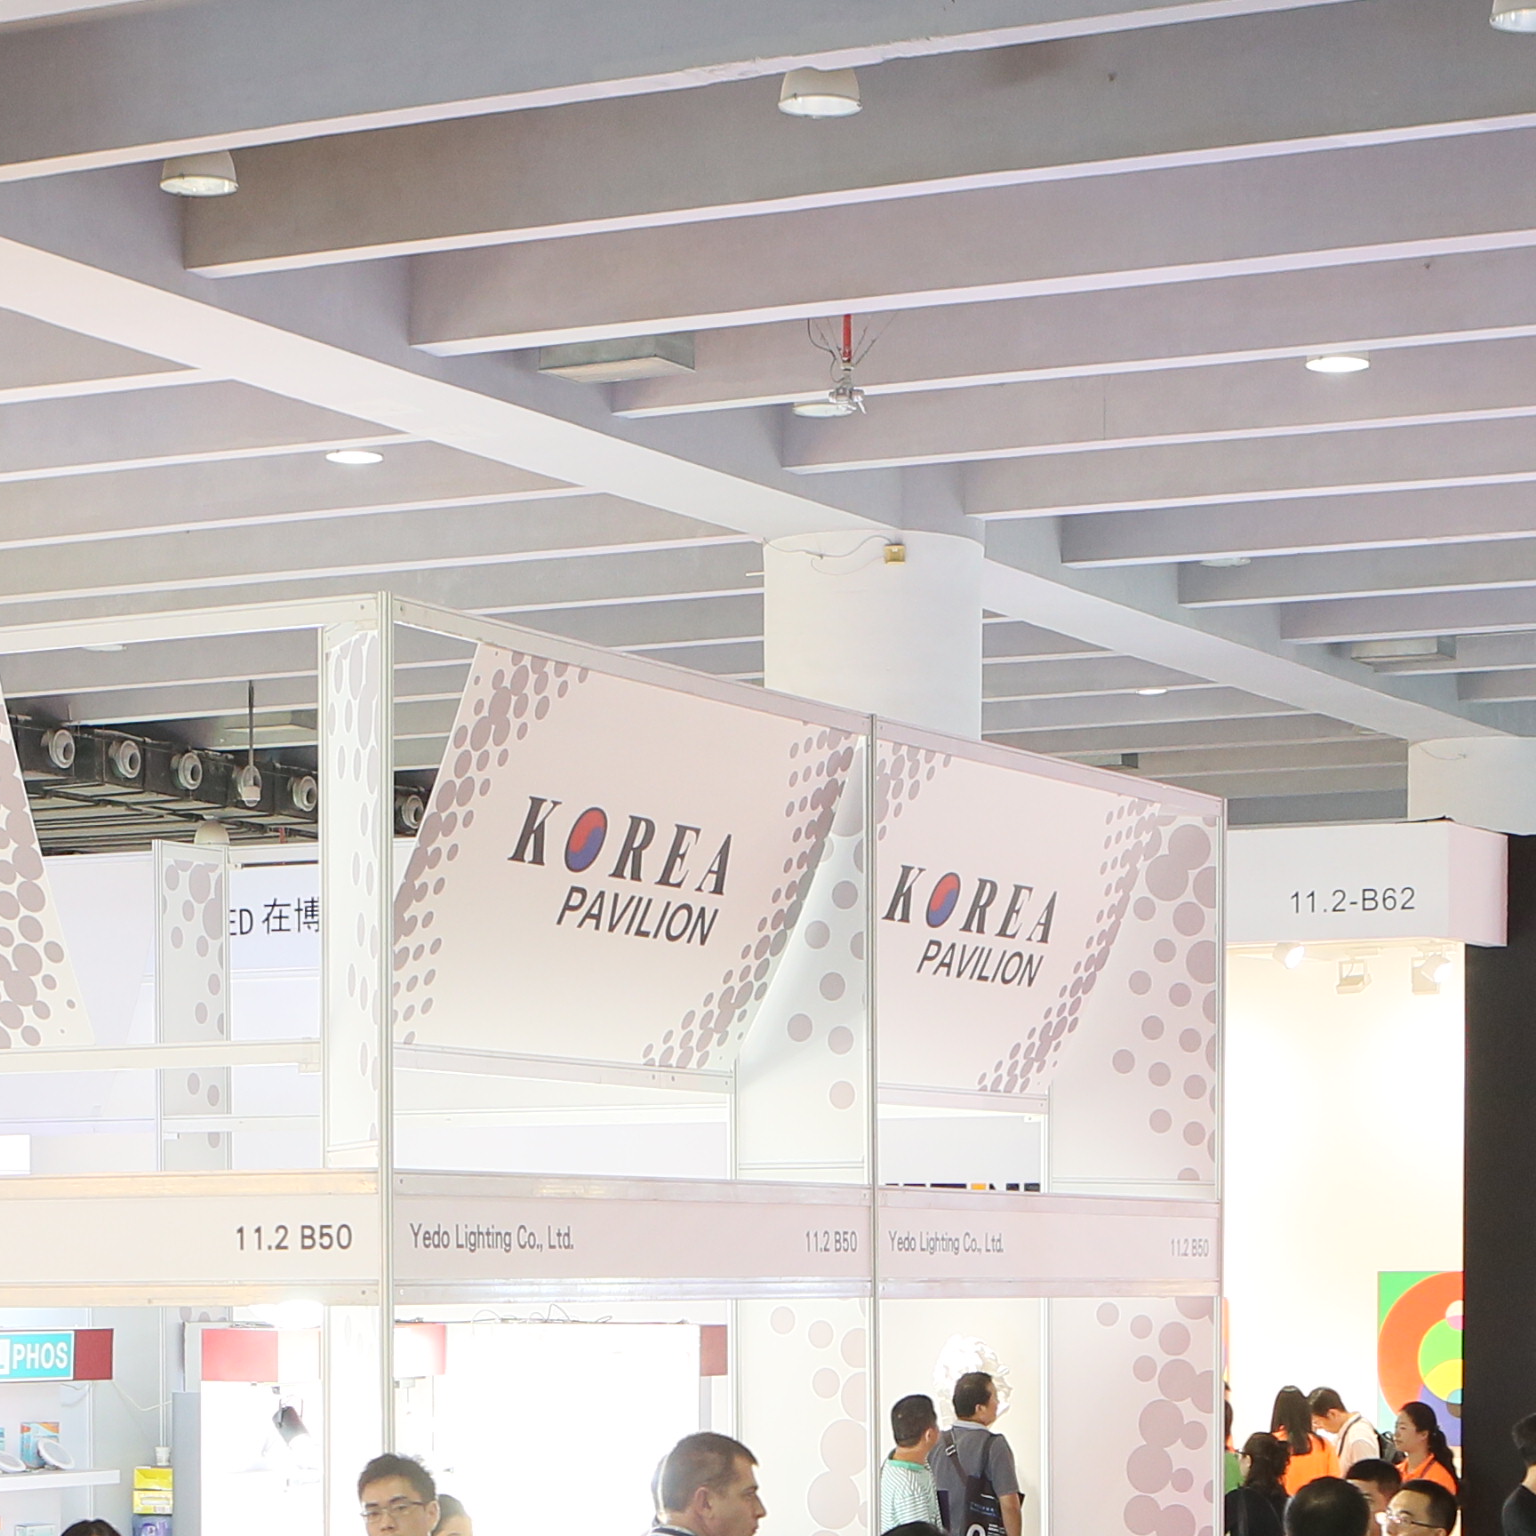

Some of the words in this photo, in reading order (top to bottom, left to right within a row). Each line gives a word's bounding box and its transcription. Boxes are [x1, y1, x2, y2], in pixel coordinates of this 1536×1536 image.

[507, 795, 733, 896] KOREA
[882, 863, 1058, 945] KOREA
[1290, 886, 1416, 914] 11.2-B62
[556, 885, 719, 946] PAVILION
[916, 939, 1045, 989] PAVILION
[236, 1225, 289, 1250] 11.2
[300, 1223, 352, 1250] B50
[409, 1223, 450, 1249] Yedo
[456, 1224, 512, 1253] Lighting
[517, 1225, 543, 1252] Co.,
[548, 1226, 574, 1250] Ltd.
[805, 1231, 830, 1253] 11.2
[834, 1231, 857, 1253] B50
[888, 1230, 916, 1251] Yedo
[919, 1232, 960, 1255] Lighting
[963, 1232, 982, 1254] Co.,
[985, 1233, 1004, 1254] Ltd.
[1170, 1238, 1189, 1257] 11.2
[1191, 1238, 1209, 1258] B50
